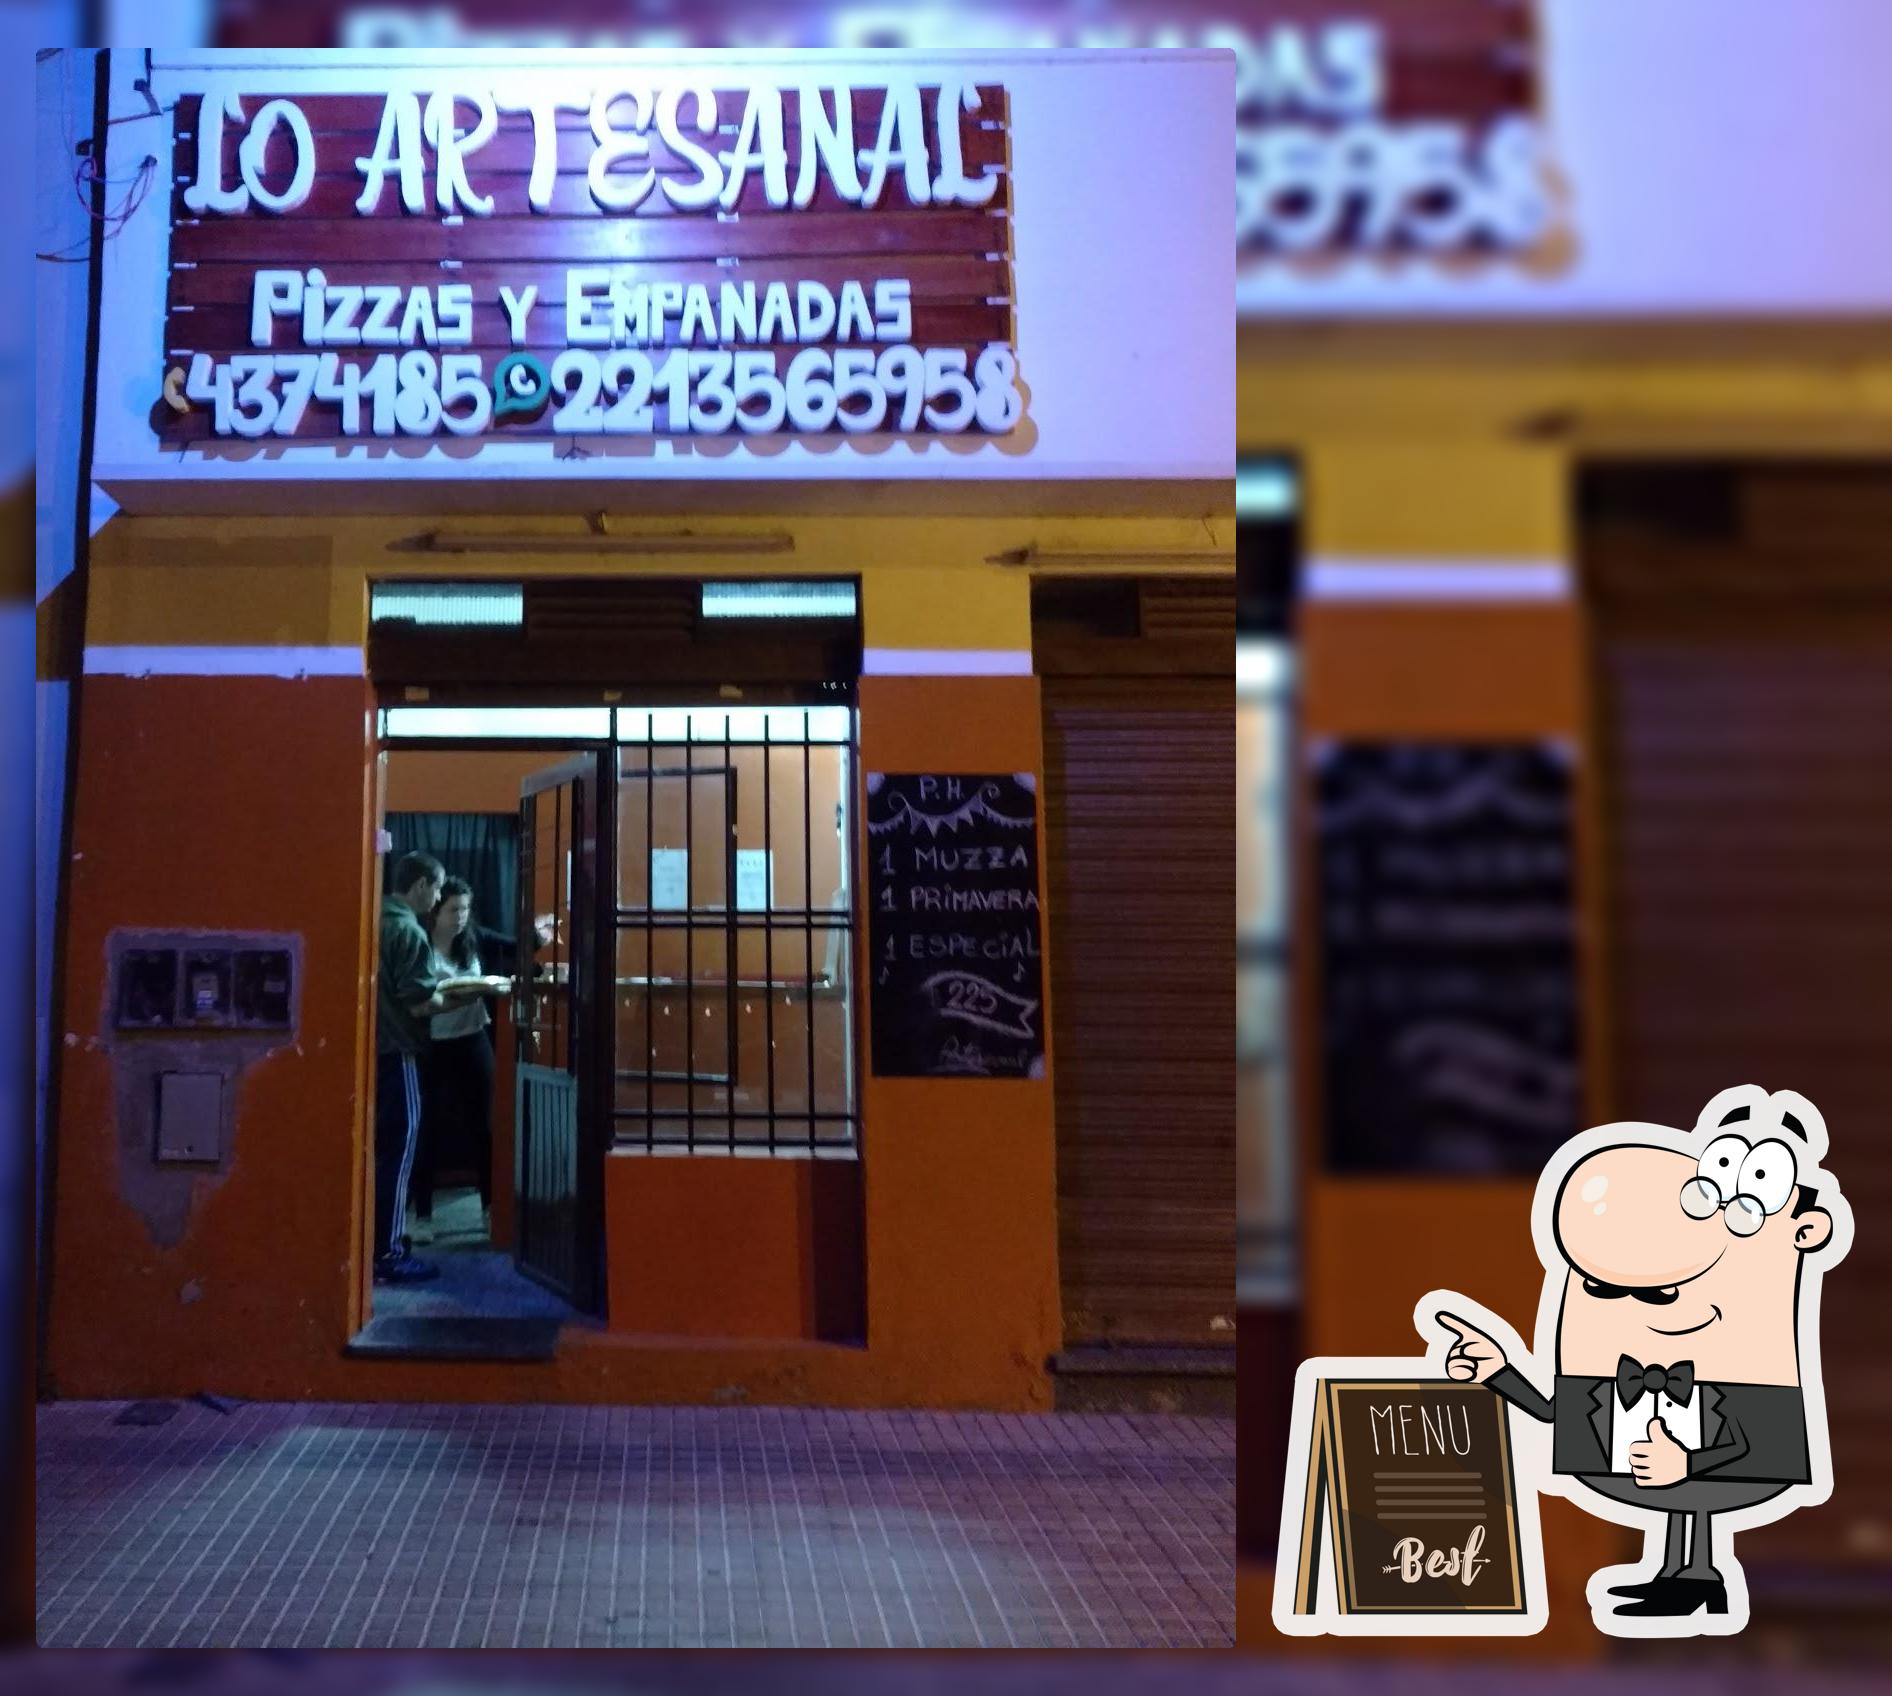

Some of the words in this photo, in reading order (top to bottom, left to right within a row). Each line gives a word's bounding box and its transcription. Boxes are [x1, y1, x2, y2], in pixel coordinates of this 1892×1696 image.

[183, 86, 316, 216] LO
[355, 82, 999, 216] ARTESANAL
[499, 285, 538, 346] Y
[565, 268, 912, 346] EMPANADAS
[186, 351, 494, 438] 4374185
[550, 346, 1023, 437] 2213565958
[881, 843, 896, 875] 1
[914, 844, 1029, 872] MUZZA
[880, 883, 897, 912] 1
[885, 933, 897, 961] 1
